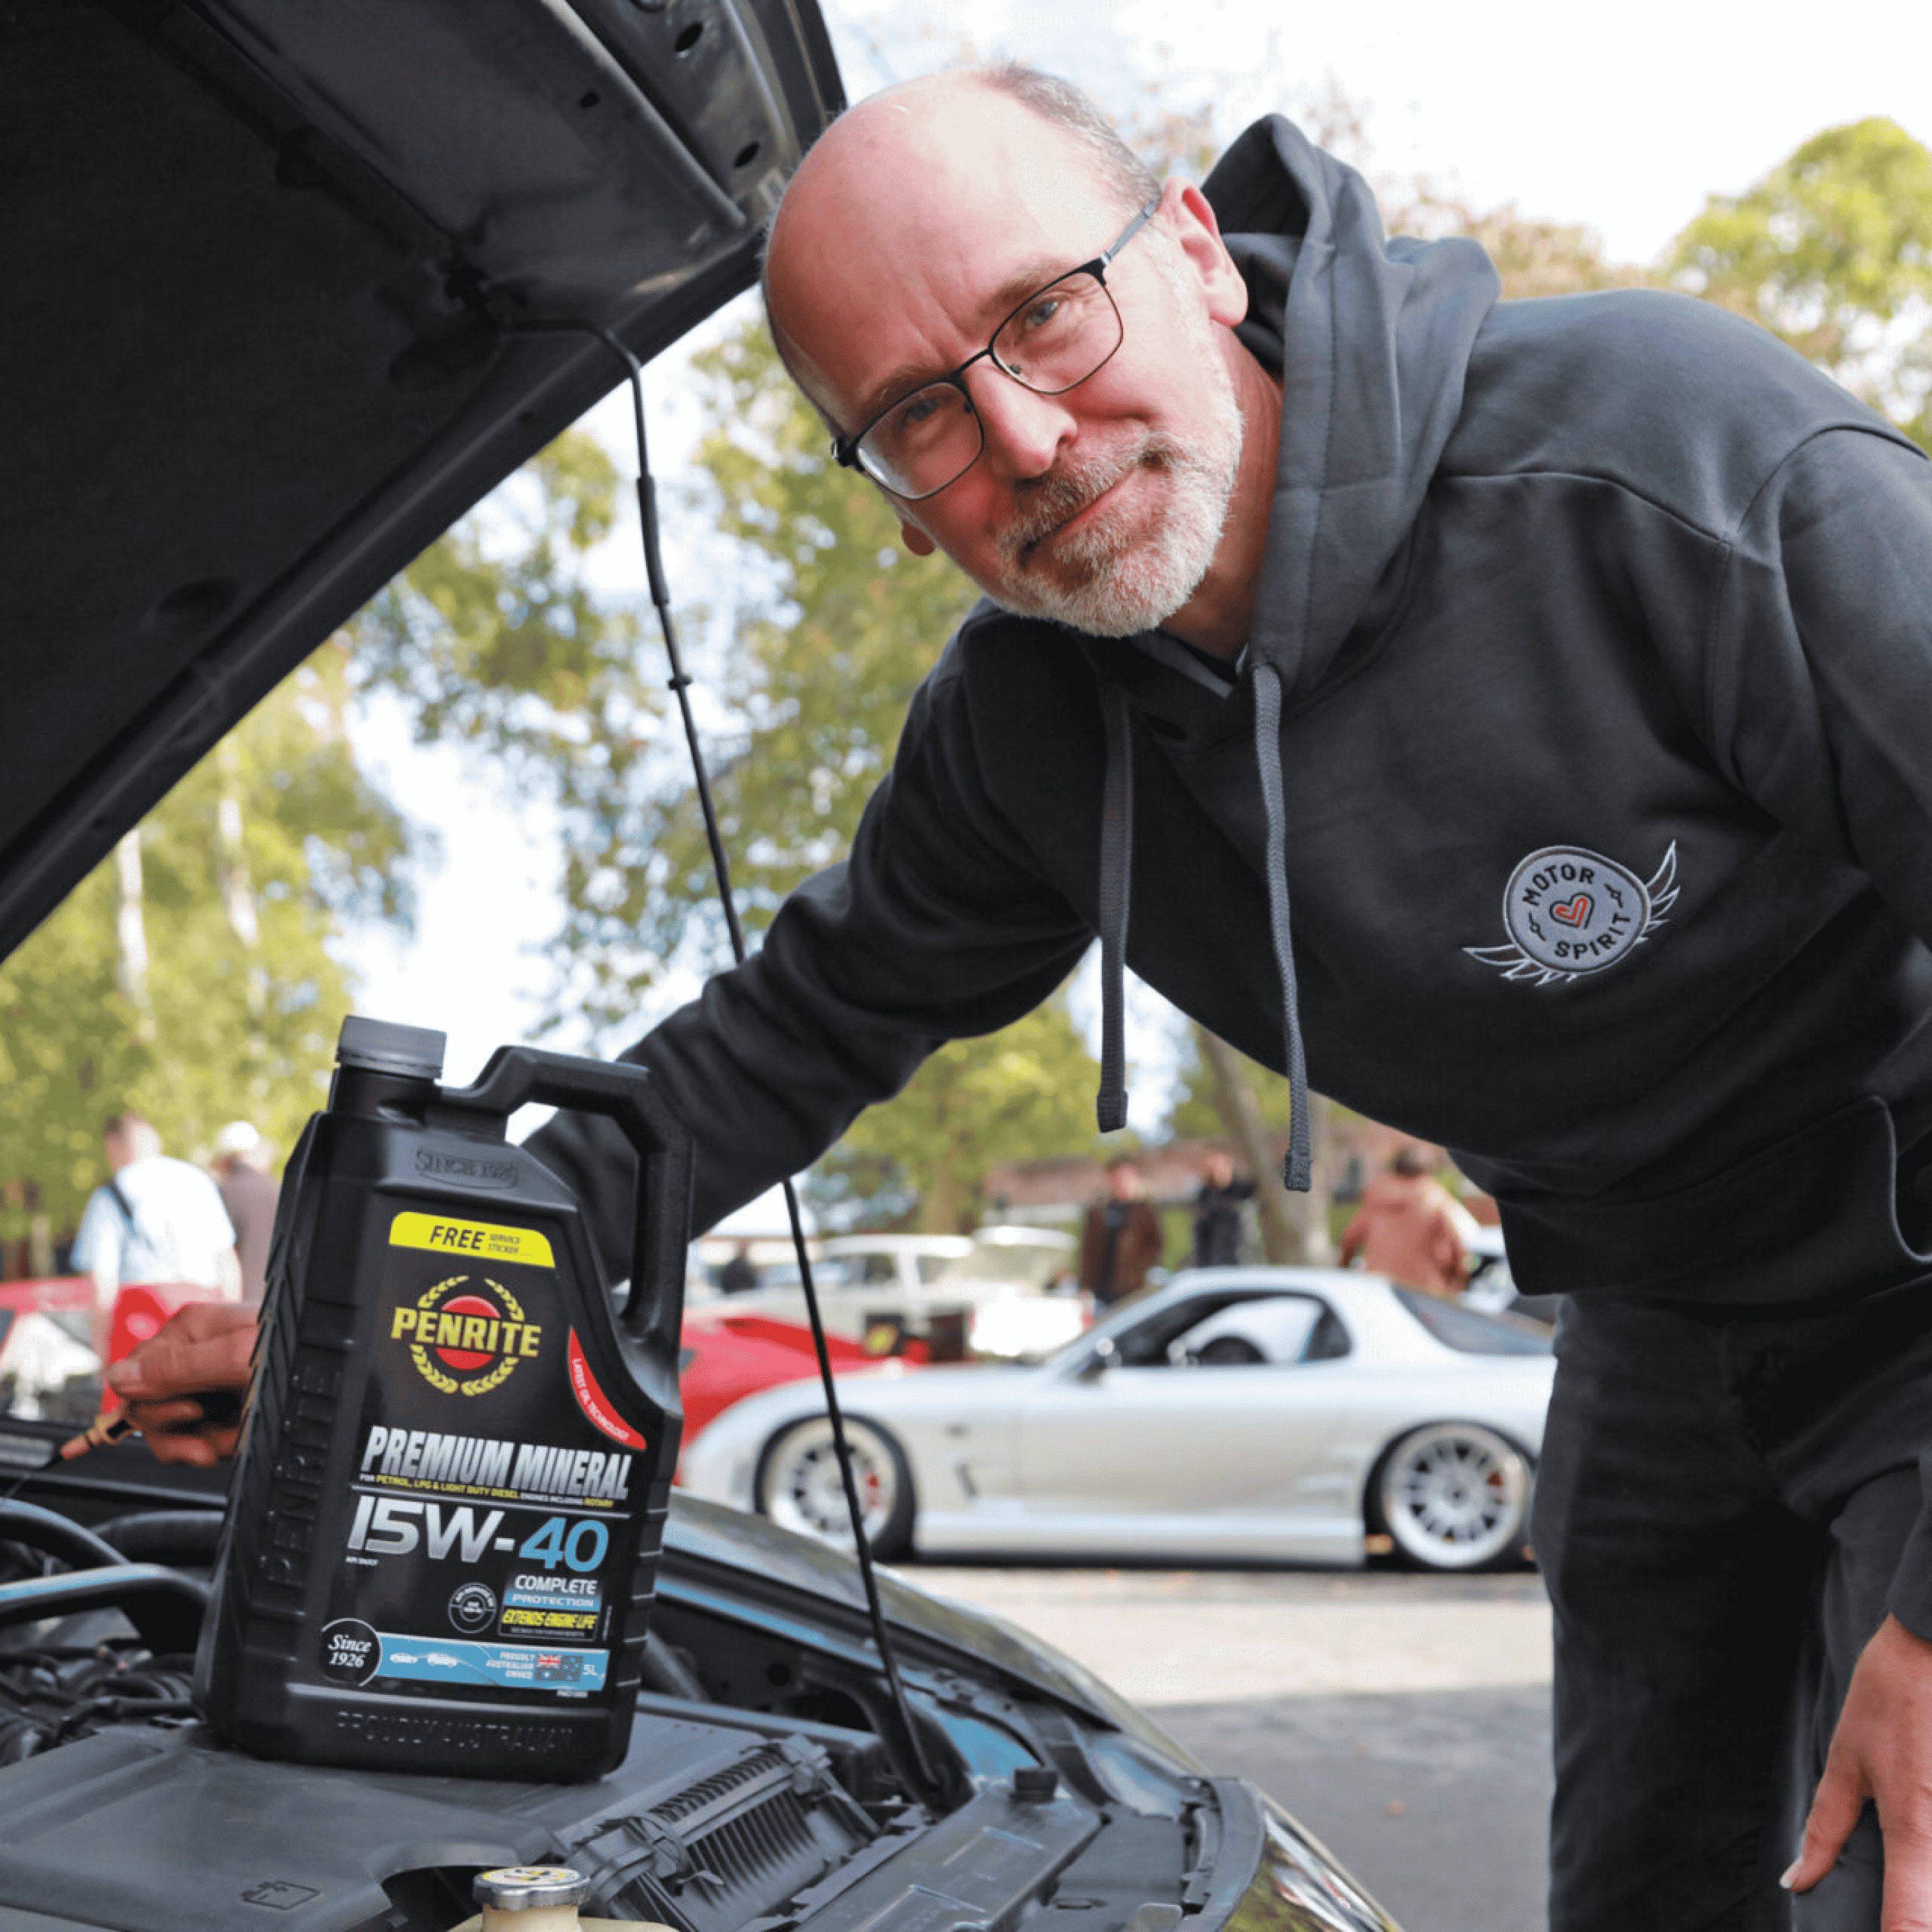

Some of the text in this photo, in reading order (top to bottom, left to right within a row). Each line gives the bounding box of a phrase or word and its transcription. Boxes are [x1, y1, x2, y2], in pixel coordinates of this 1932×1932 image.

[1522, 864, 1595, 906] MOTOR
[1554, 912, 1630, 959] SPIRIT
[429, 1225, 486, 1250] FREE
[391, 1307, 542, 1357] PENRITE
[360, 1425, 632, 1500] PREMIUM MINERAL
[346, 1495, 609, 1572] 15W-40
[511, 1593, 594, 1608] PROTECTION
[515, 1573, 598, 1595] COMPLETE
[327, 1634, 372, 1653] Since
[328, 1651, 366, 1668] 1926
